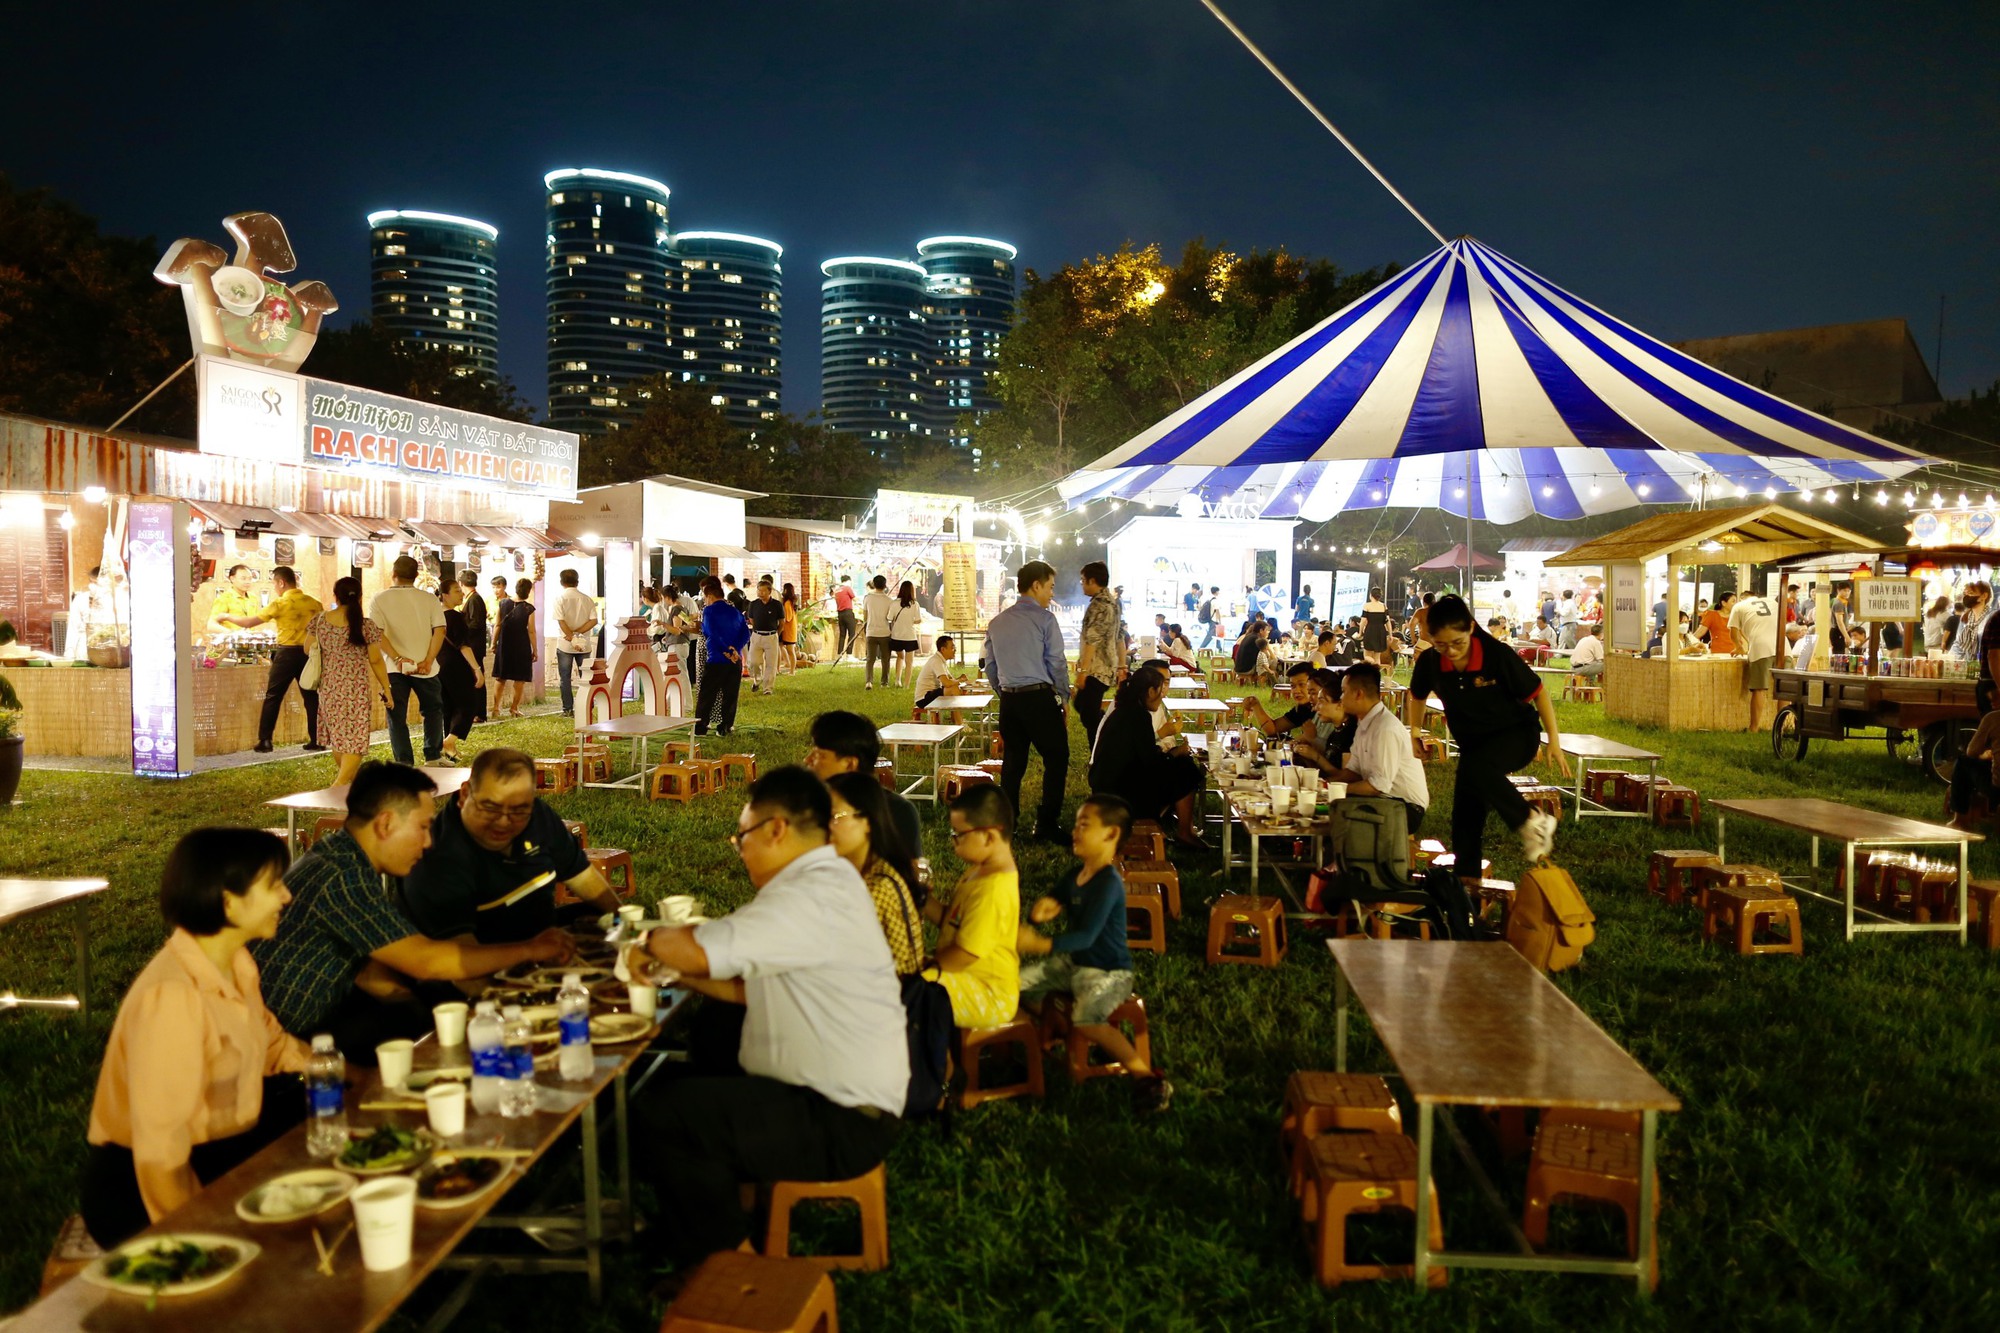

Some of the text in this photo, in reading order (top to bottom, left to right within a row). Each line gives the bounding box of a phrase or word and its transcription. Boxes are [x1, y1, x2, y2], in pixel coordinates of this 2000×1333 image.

[220, 384, 261, 401] SAIGON
[418, 415, 458, 441] SẢN
[462, 425, 500, 447] VẬT
[502, 432, 536, 453] ĐẤT
[311, 424, 572, 490] RẠCH GIÁ KIÊN GIANG
[1615, 597, 1637, 612] COUPON
[1751, 601, 1771, 616] 3
